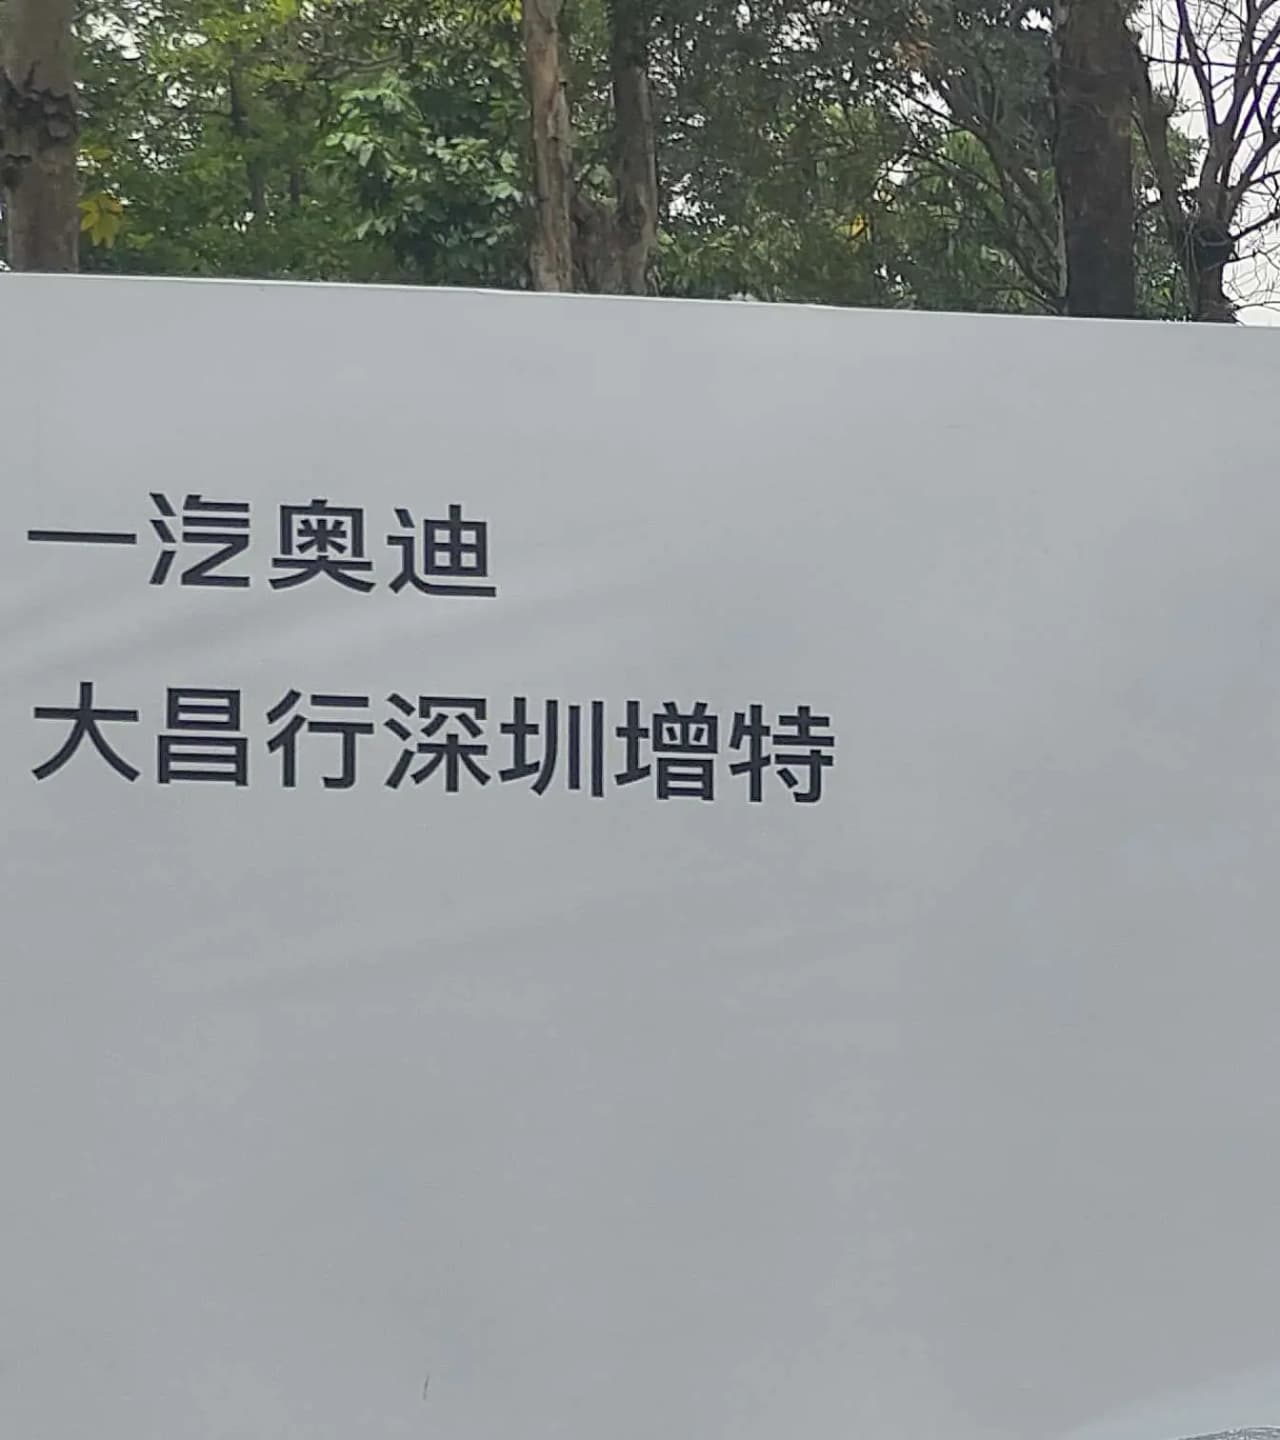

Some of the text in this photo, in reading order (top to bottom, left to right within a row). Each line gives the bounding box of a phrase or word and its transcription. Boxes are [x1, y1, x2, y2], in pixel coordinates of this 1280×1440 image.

[27, 492, 497, 597] 一汽奥迪
[31, 680, 836, 804] 大昌行深圳增特
